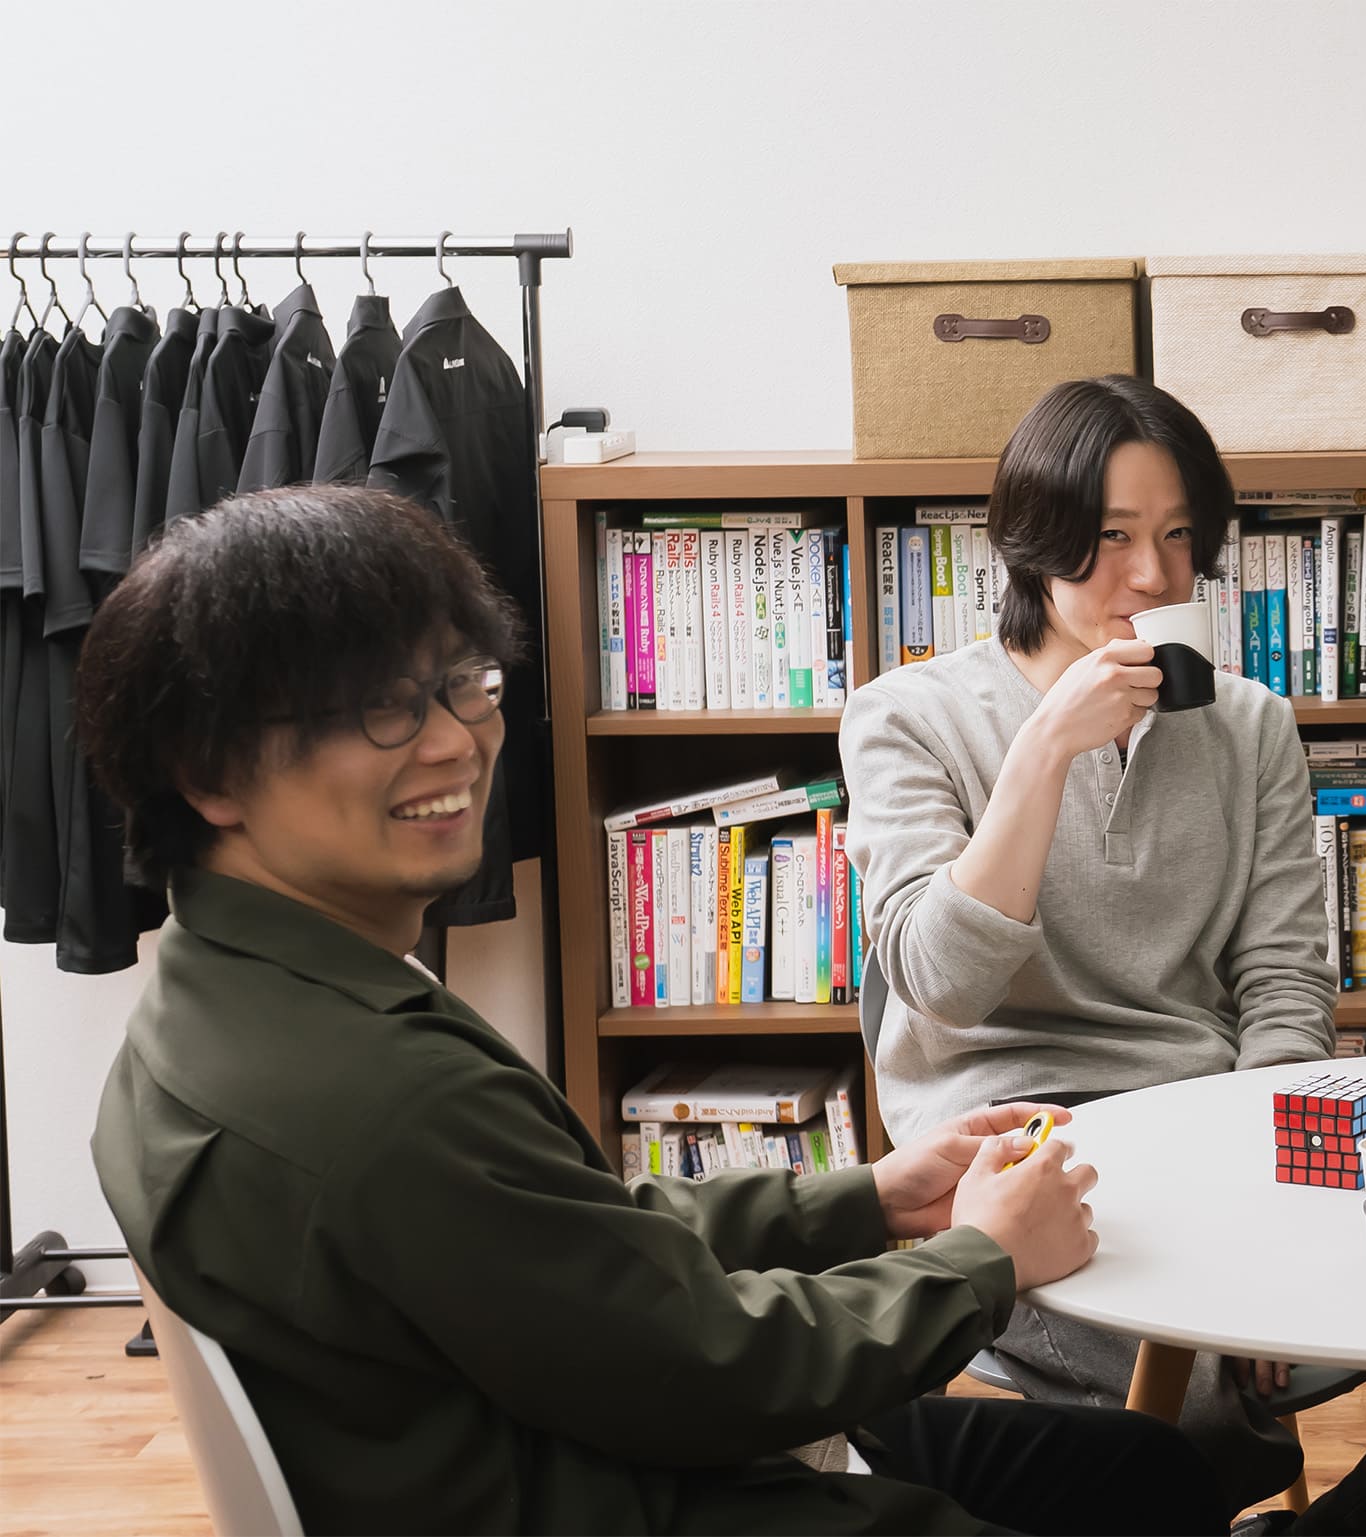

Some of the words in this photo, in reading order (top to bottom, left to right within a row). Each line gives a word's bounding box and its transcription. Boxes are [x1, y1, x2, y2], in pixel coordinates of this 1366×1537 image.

[667, 533, 681, 569] Rails
[683, 533, 698, 569] Rails
[707, 538, 719, 566] Ruby
[732, 538, 743, 566] Ruby
[771, 532, 784, 568] Vue.js
[933, 528, 944, 557] Spring
[953, 533, 964, 563] Spring
[1324, 525, 1337, 564] Angular
[752, 534, 766, 592] Node.js
[808, 533, 822, 586] Docker
[935, 556, 949, 588] Boot
[655, 569, 665, 593] Ruby
[710, 568, 718, 582] on
[734, 568, 742, 582] on
[956, 564, 970, 598] Boot
[974, 568, 988, 611] Spring
[710, 584, 720, 610] Rails
[734, 584, 744, 610] Rails
[773, 579, 786, 621] Nuxt.js
[1304, 582, 1314, 633] MongoDB
[656, 609, 666, 633] Rails
[640, 628, 650, 654] Ruby
[1249, 630, 1261, 652] 入門
[1270, 628, 1283, 649] 入門
[690, 832, 704, 876] Struts2
[1320, 824, 1334, 854] iOS
[609, 836, 622, 913] JavaScript
[655, 847, 665, 909] WordPress
[719, 845, 730, 892] Sublime
[746, 879, 762, 905] Web
[776, 864, 789, 907] Visual
[719, 893, 730, 916] Text
[731, 888, 742, 917] Web
[746, 905, 761, 929] API
[636, 884, 650, 953] WordPress
[730, 920, 741, 944] API
[776, 907, 789, 937] C++
